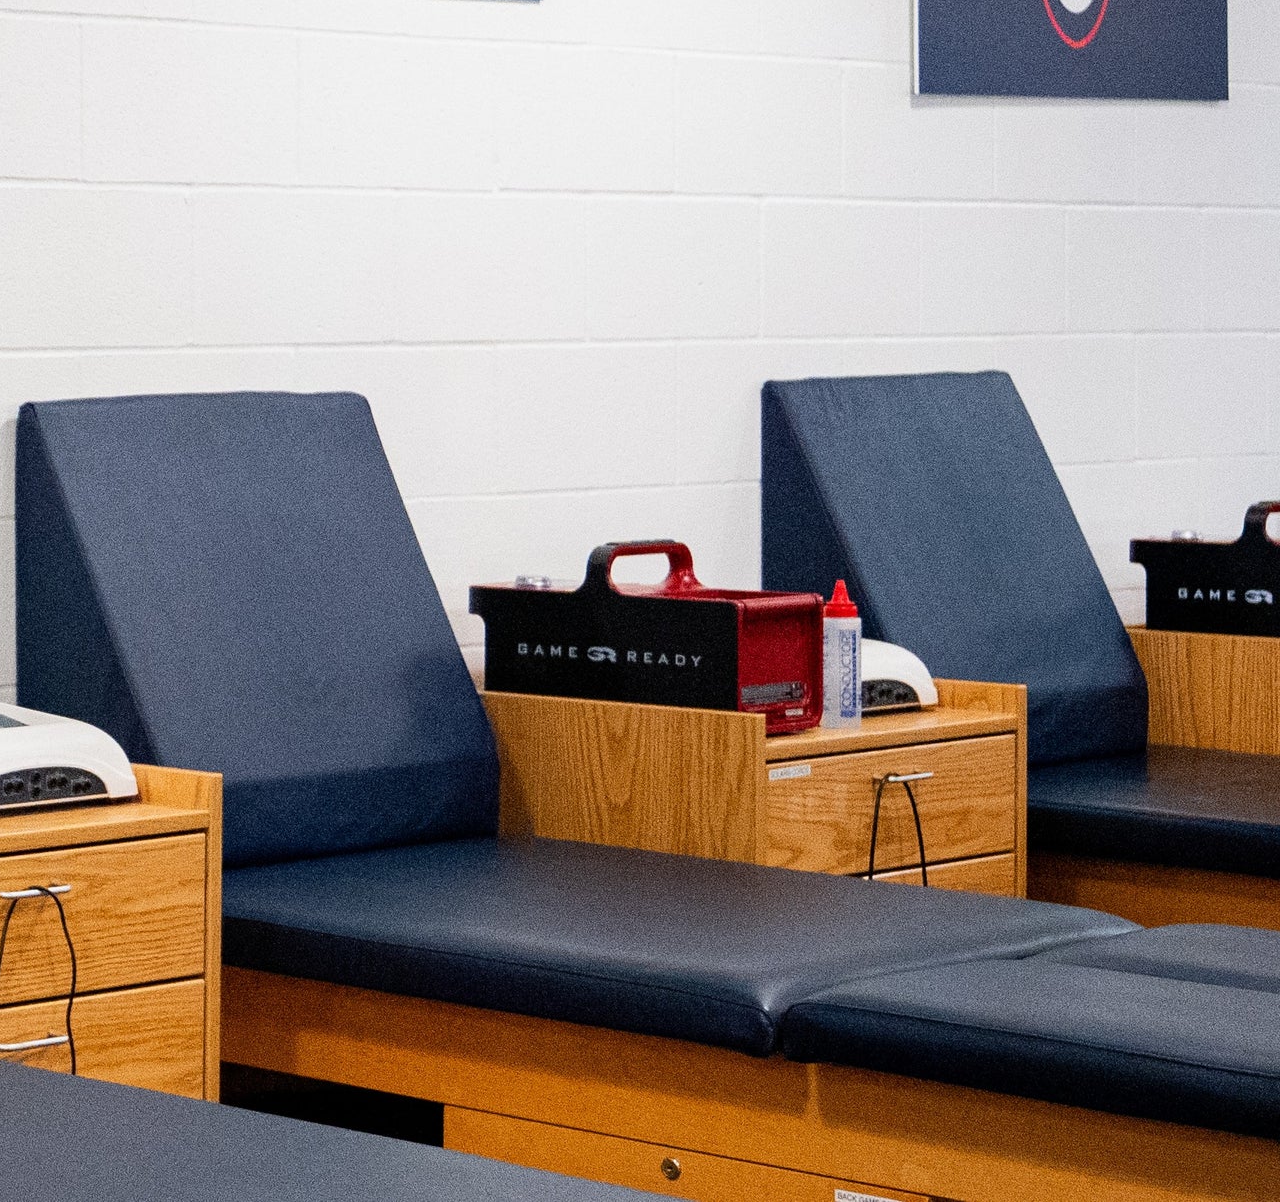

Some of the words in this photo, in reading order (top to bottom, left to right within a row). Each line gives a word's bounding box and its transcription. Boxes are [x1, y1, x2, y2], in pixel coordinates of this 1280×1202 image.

[1177, 586, 1237, 601] GAME
[517, 643, 579, 659] GAME
[626, 650, 702, 667] READY
